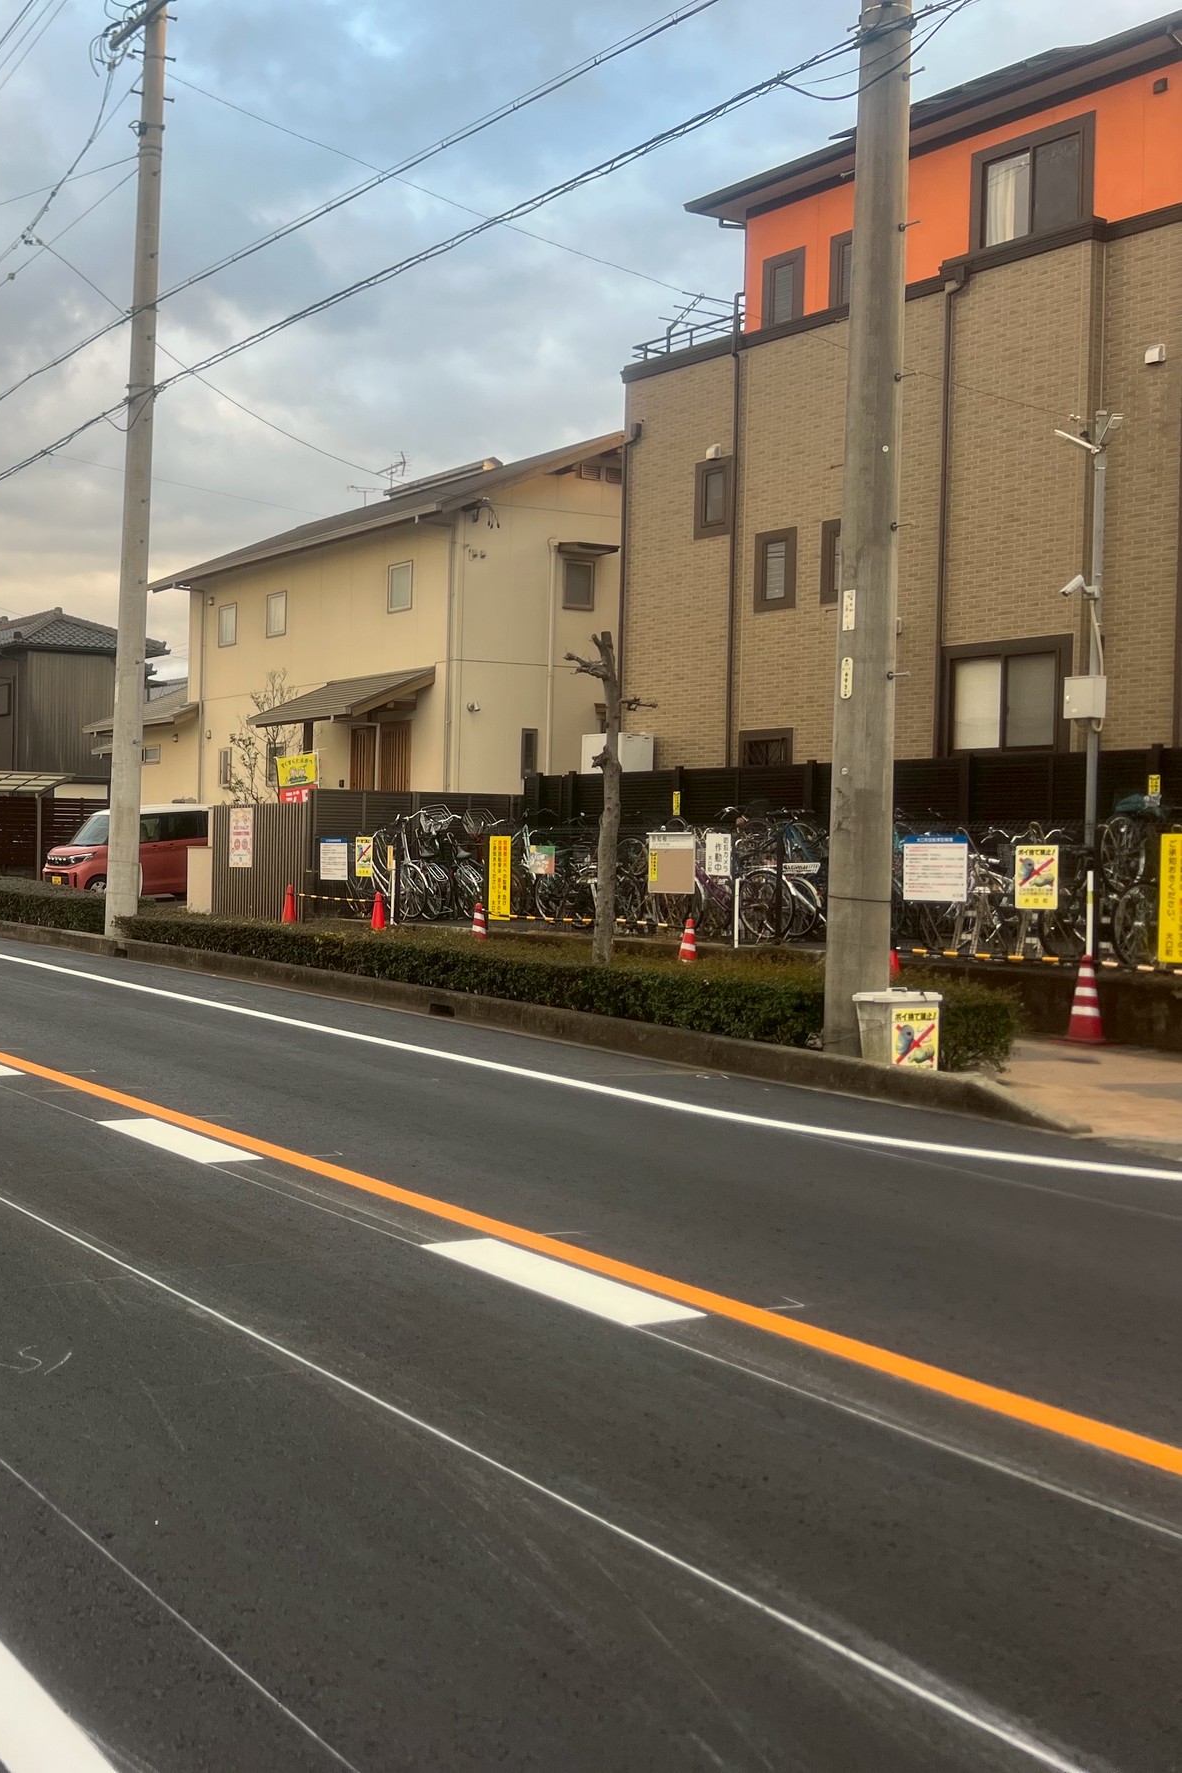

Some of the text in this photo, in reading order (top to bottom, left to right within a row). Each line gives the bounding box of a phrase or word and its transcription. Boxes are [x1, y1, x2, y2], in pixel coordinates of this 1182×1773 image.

[714, 843, 722, 872] 作動中
[894, 1011, 937, 1021] ポイ捨て禁止!
